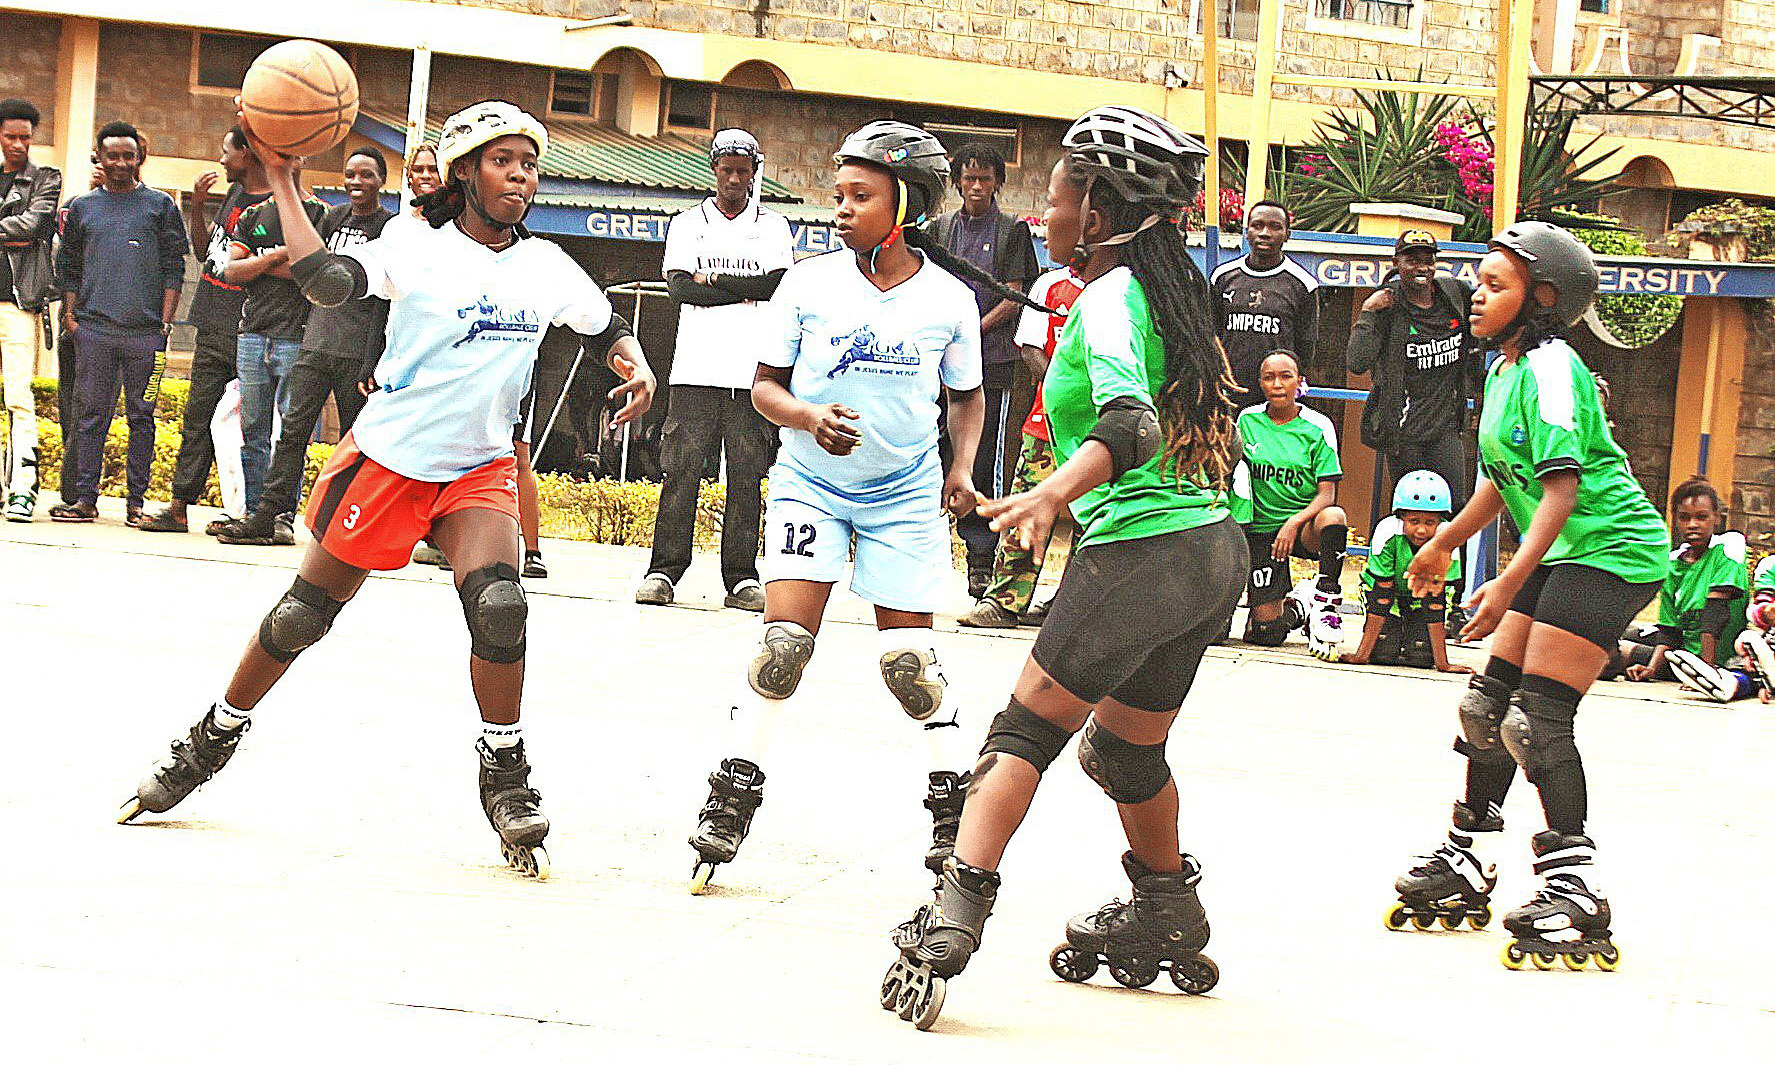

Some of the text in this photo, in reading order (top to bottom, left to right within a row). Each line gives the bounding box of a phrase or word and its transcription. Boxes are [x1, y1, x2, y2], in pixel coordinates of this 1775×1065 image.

[587, 212, 670, 238] GRET
[697, 256, 760, 271] Emirates
[1317, 259, 1727, 294] GRSA ERSITY
[1406, 332, 1463, 358] Emirate
[1252, 463, 1305, 487] NIPERS
[344, 504, 361, 530] 3
[781, 522, 816, 557] 12
[1252, 567, 1273, 588] 07
